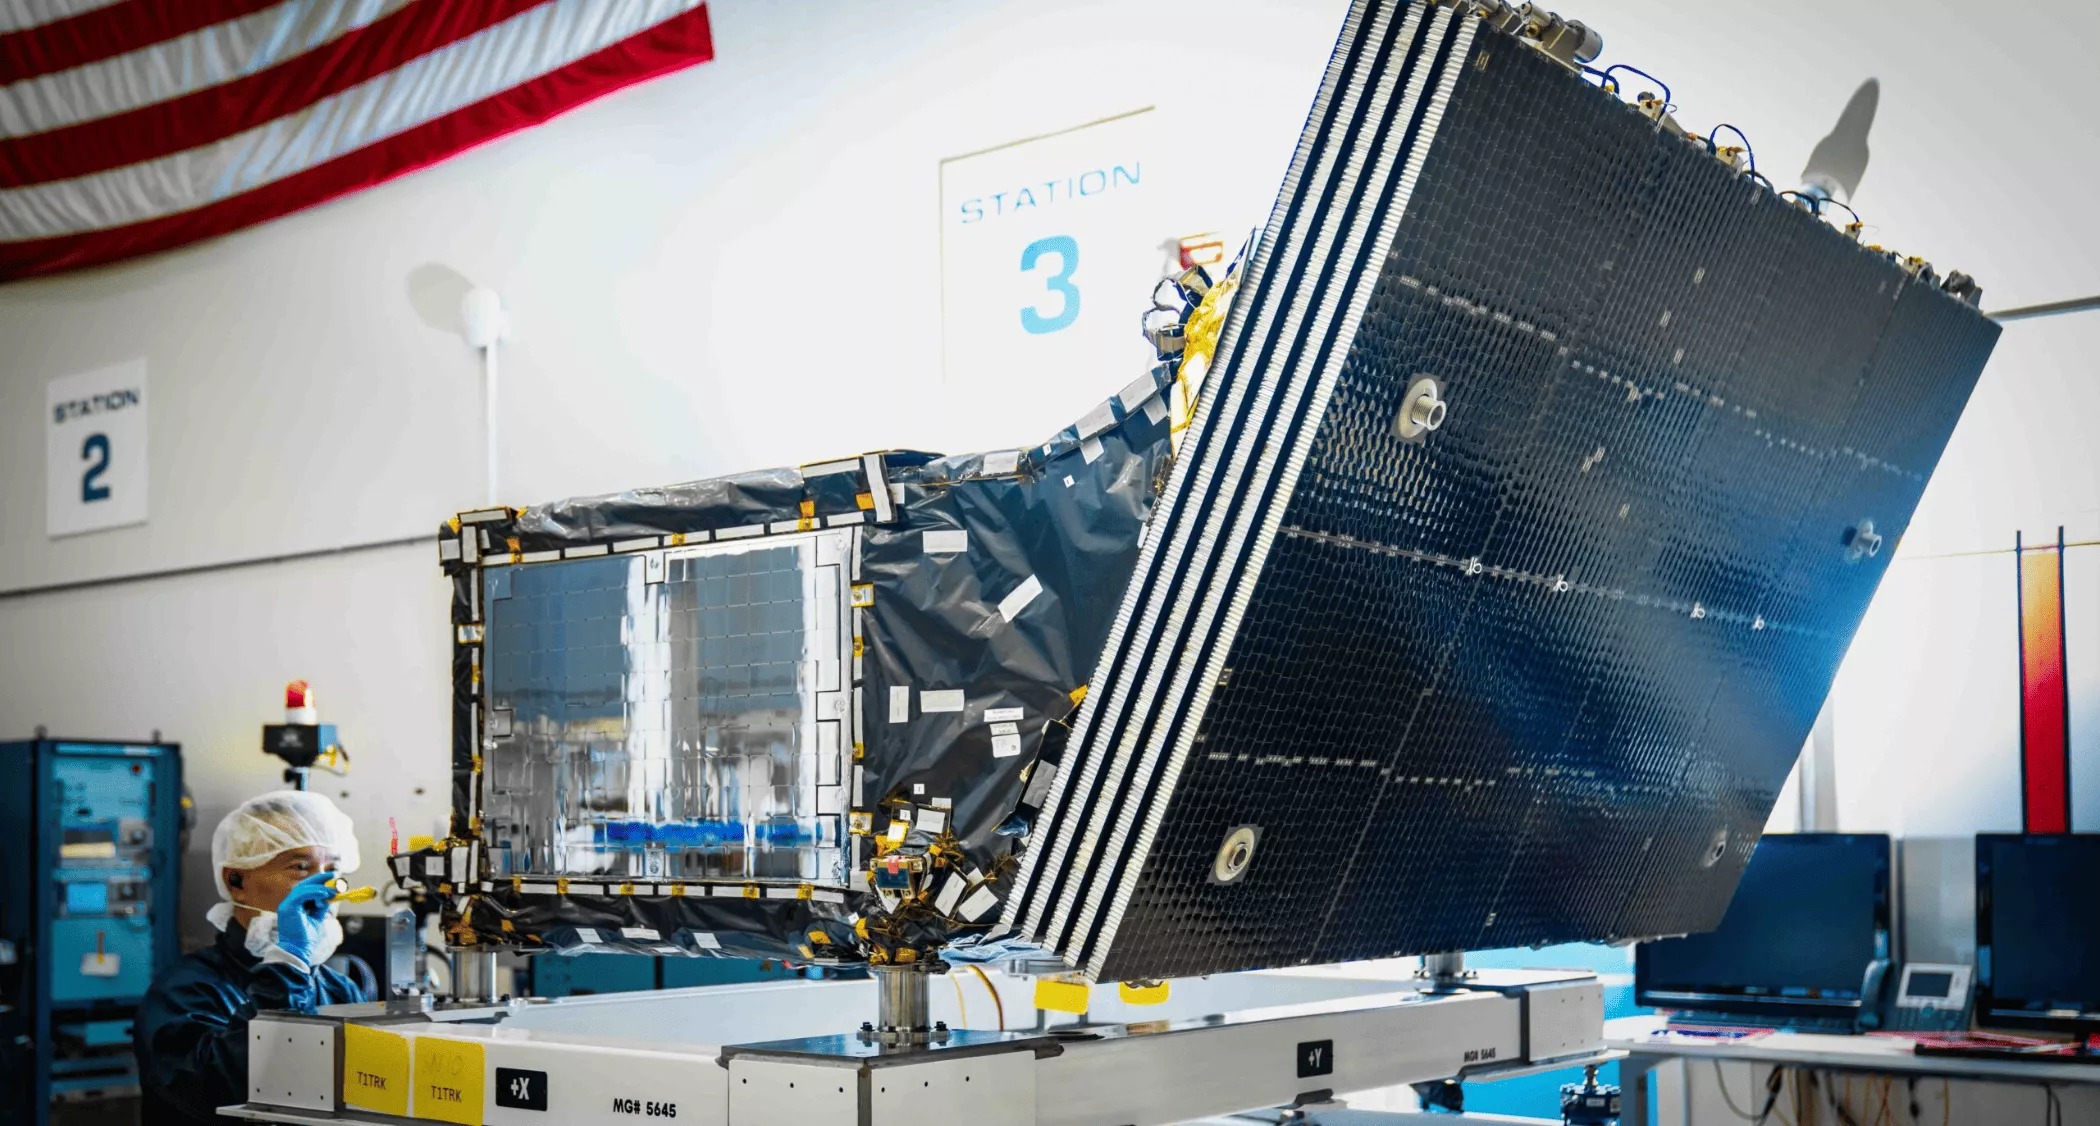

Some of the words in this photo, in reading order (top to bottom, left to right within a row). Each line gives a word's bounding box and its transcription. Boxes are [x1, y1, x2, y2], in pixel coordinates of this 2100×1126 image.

[960, 161, 1140, 224] STATION
[1020, 234, 1081, 335] 3
[53, 388, 139, 424] STATION
[81, 433, 111, 503] 2
[1308, 1047, 1323, 1068] +Y
[356, 1071, 388, 1091] T1TRK
[510, 1076, 531, 1101] +X
[430, 1085, 463, 1103] T1TRK
[612, 1097, 642, 1116] MG#
[645, 1101, 677, 1119] 5645
